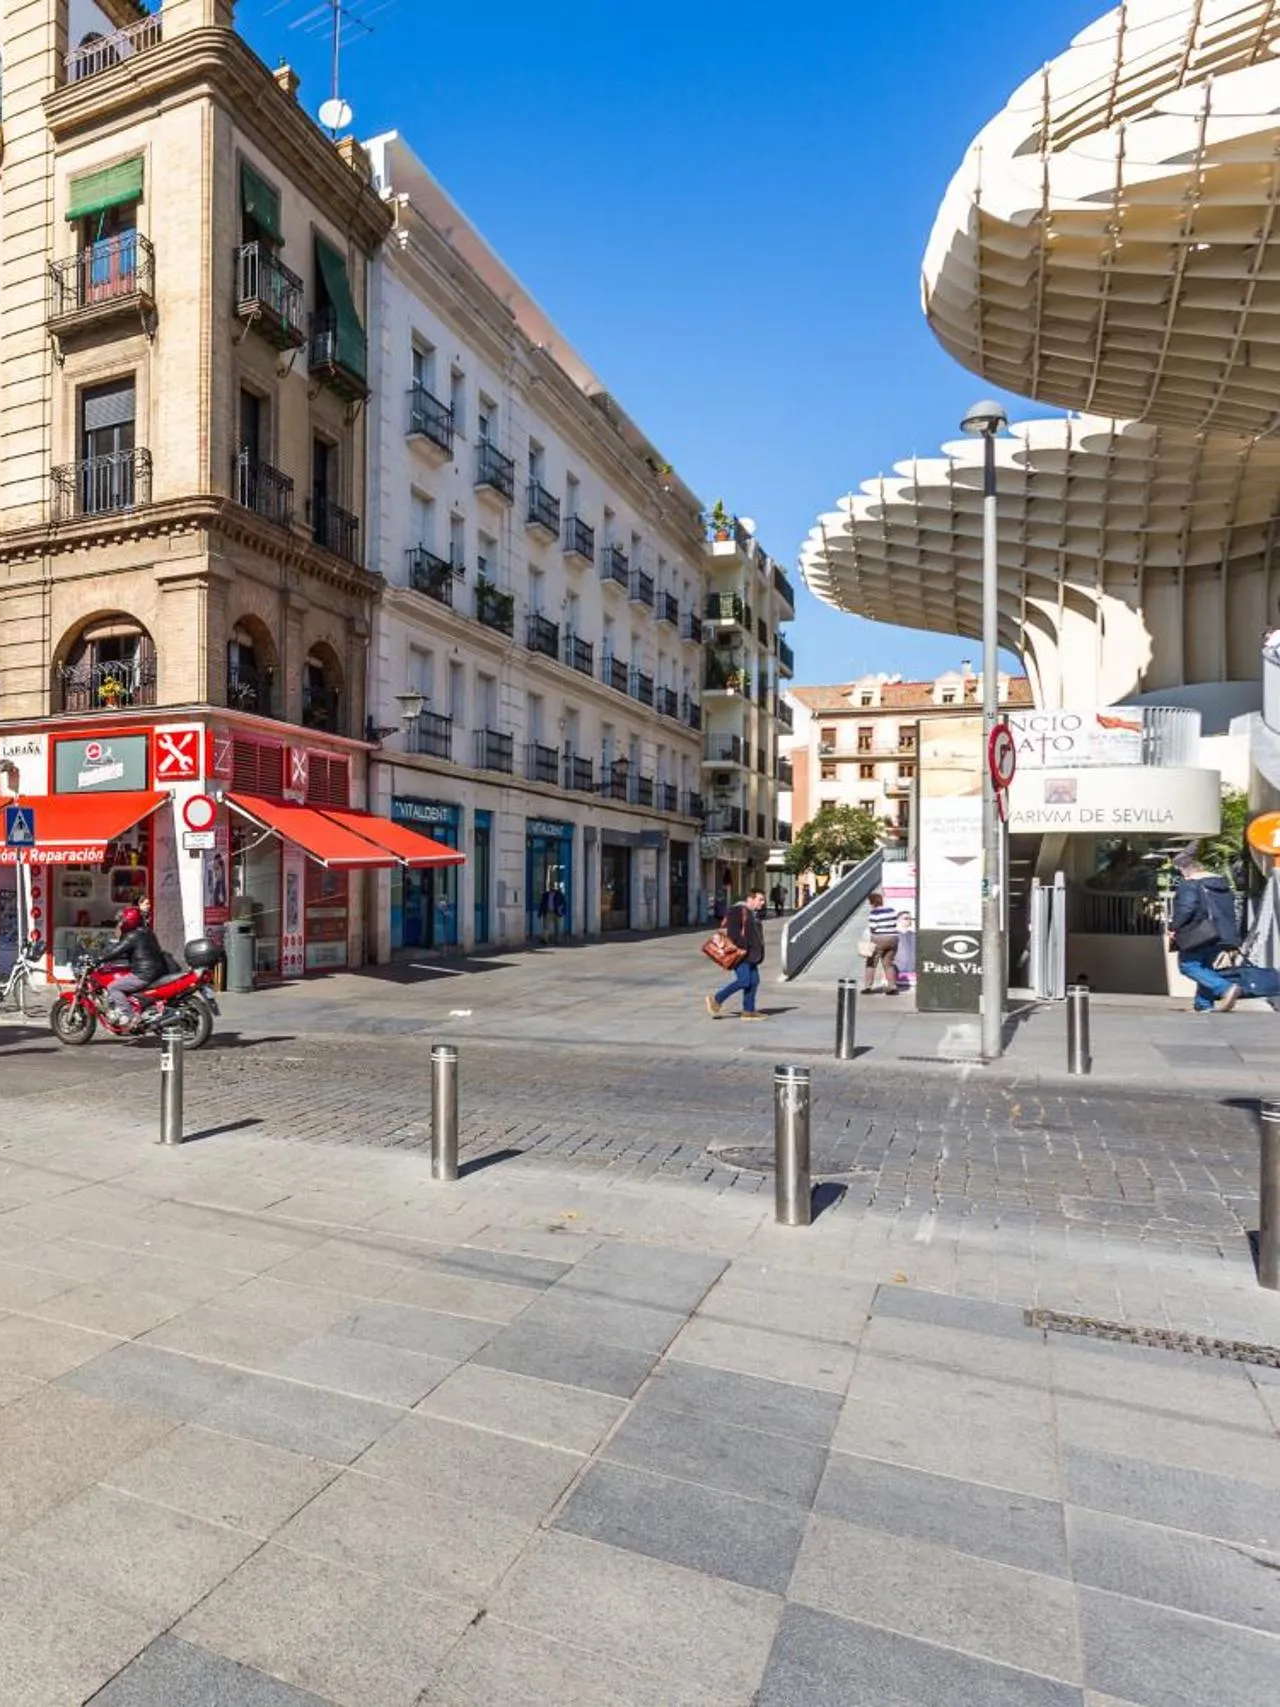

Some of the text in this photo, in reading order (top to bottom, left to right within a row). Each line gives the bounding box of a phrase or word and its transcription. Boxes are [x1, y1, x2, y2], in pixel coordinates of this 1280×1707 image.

[1079, 808, 1105, 823] DE
[1111, 808, 1174, 823] SEVILLA
[18, 852, 26, 864] y
[29, 846, 104, 864] Reparación
[922, 961, 957, 975] Past
